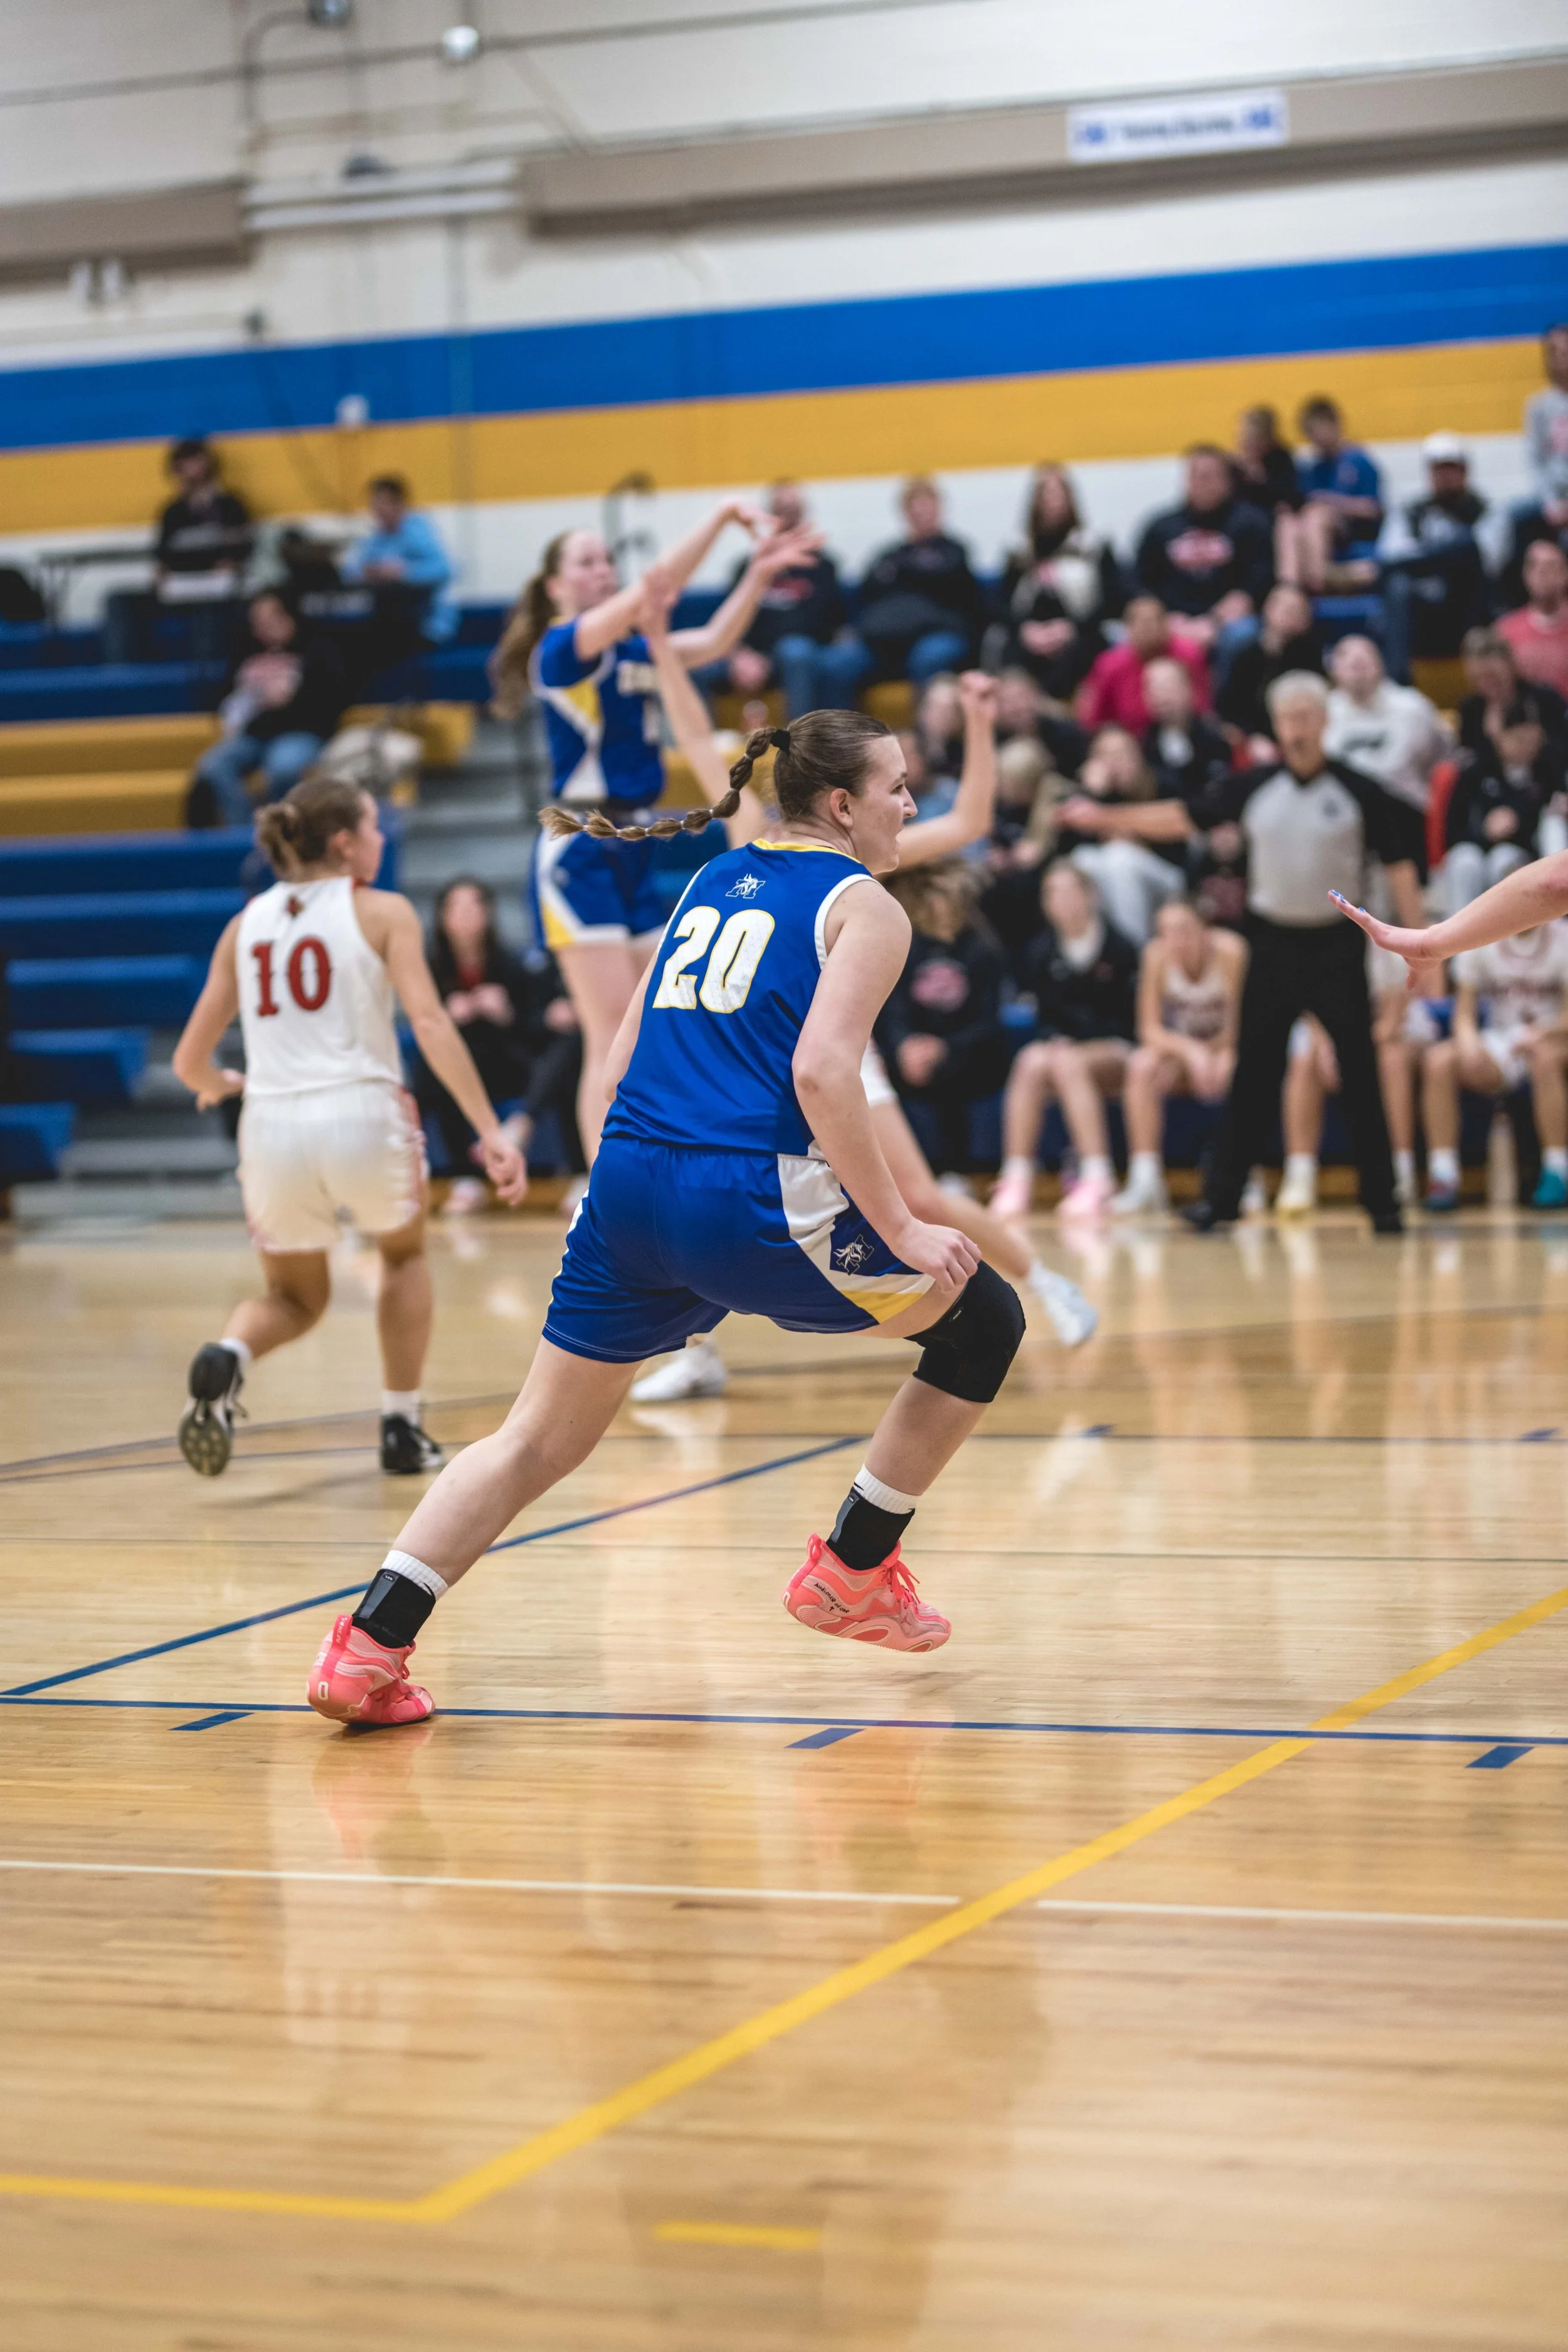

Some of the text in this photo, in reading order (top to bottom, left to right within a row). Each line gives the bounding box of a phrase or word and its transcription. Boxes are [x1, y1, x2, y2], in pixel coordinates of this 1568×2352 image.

[252, 936, 332, 1017] 10
[652, 906, 775, 1014] 20
[813, 1582, 836, 1602] Audience
